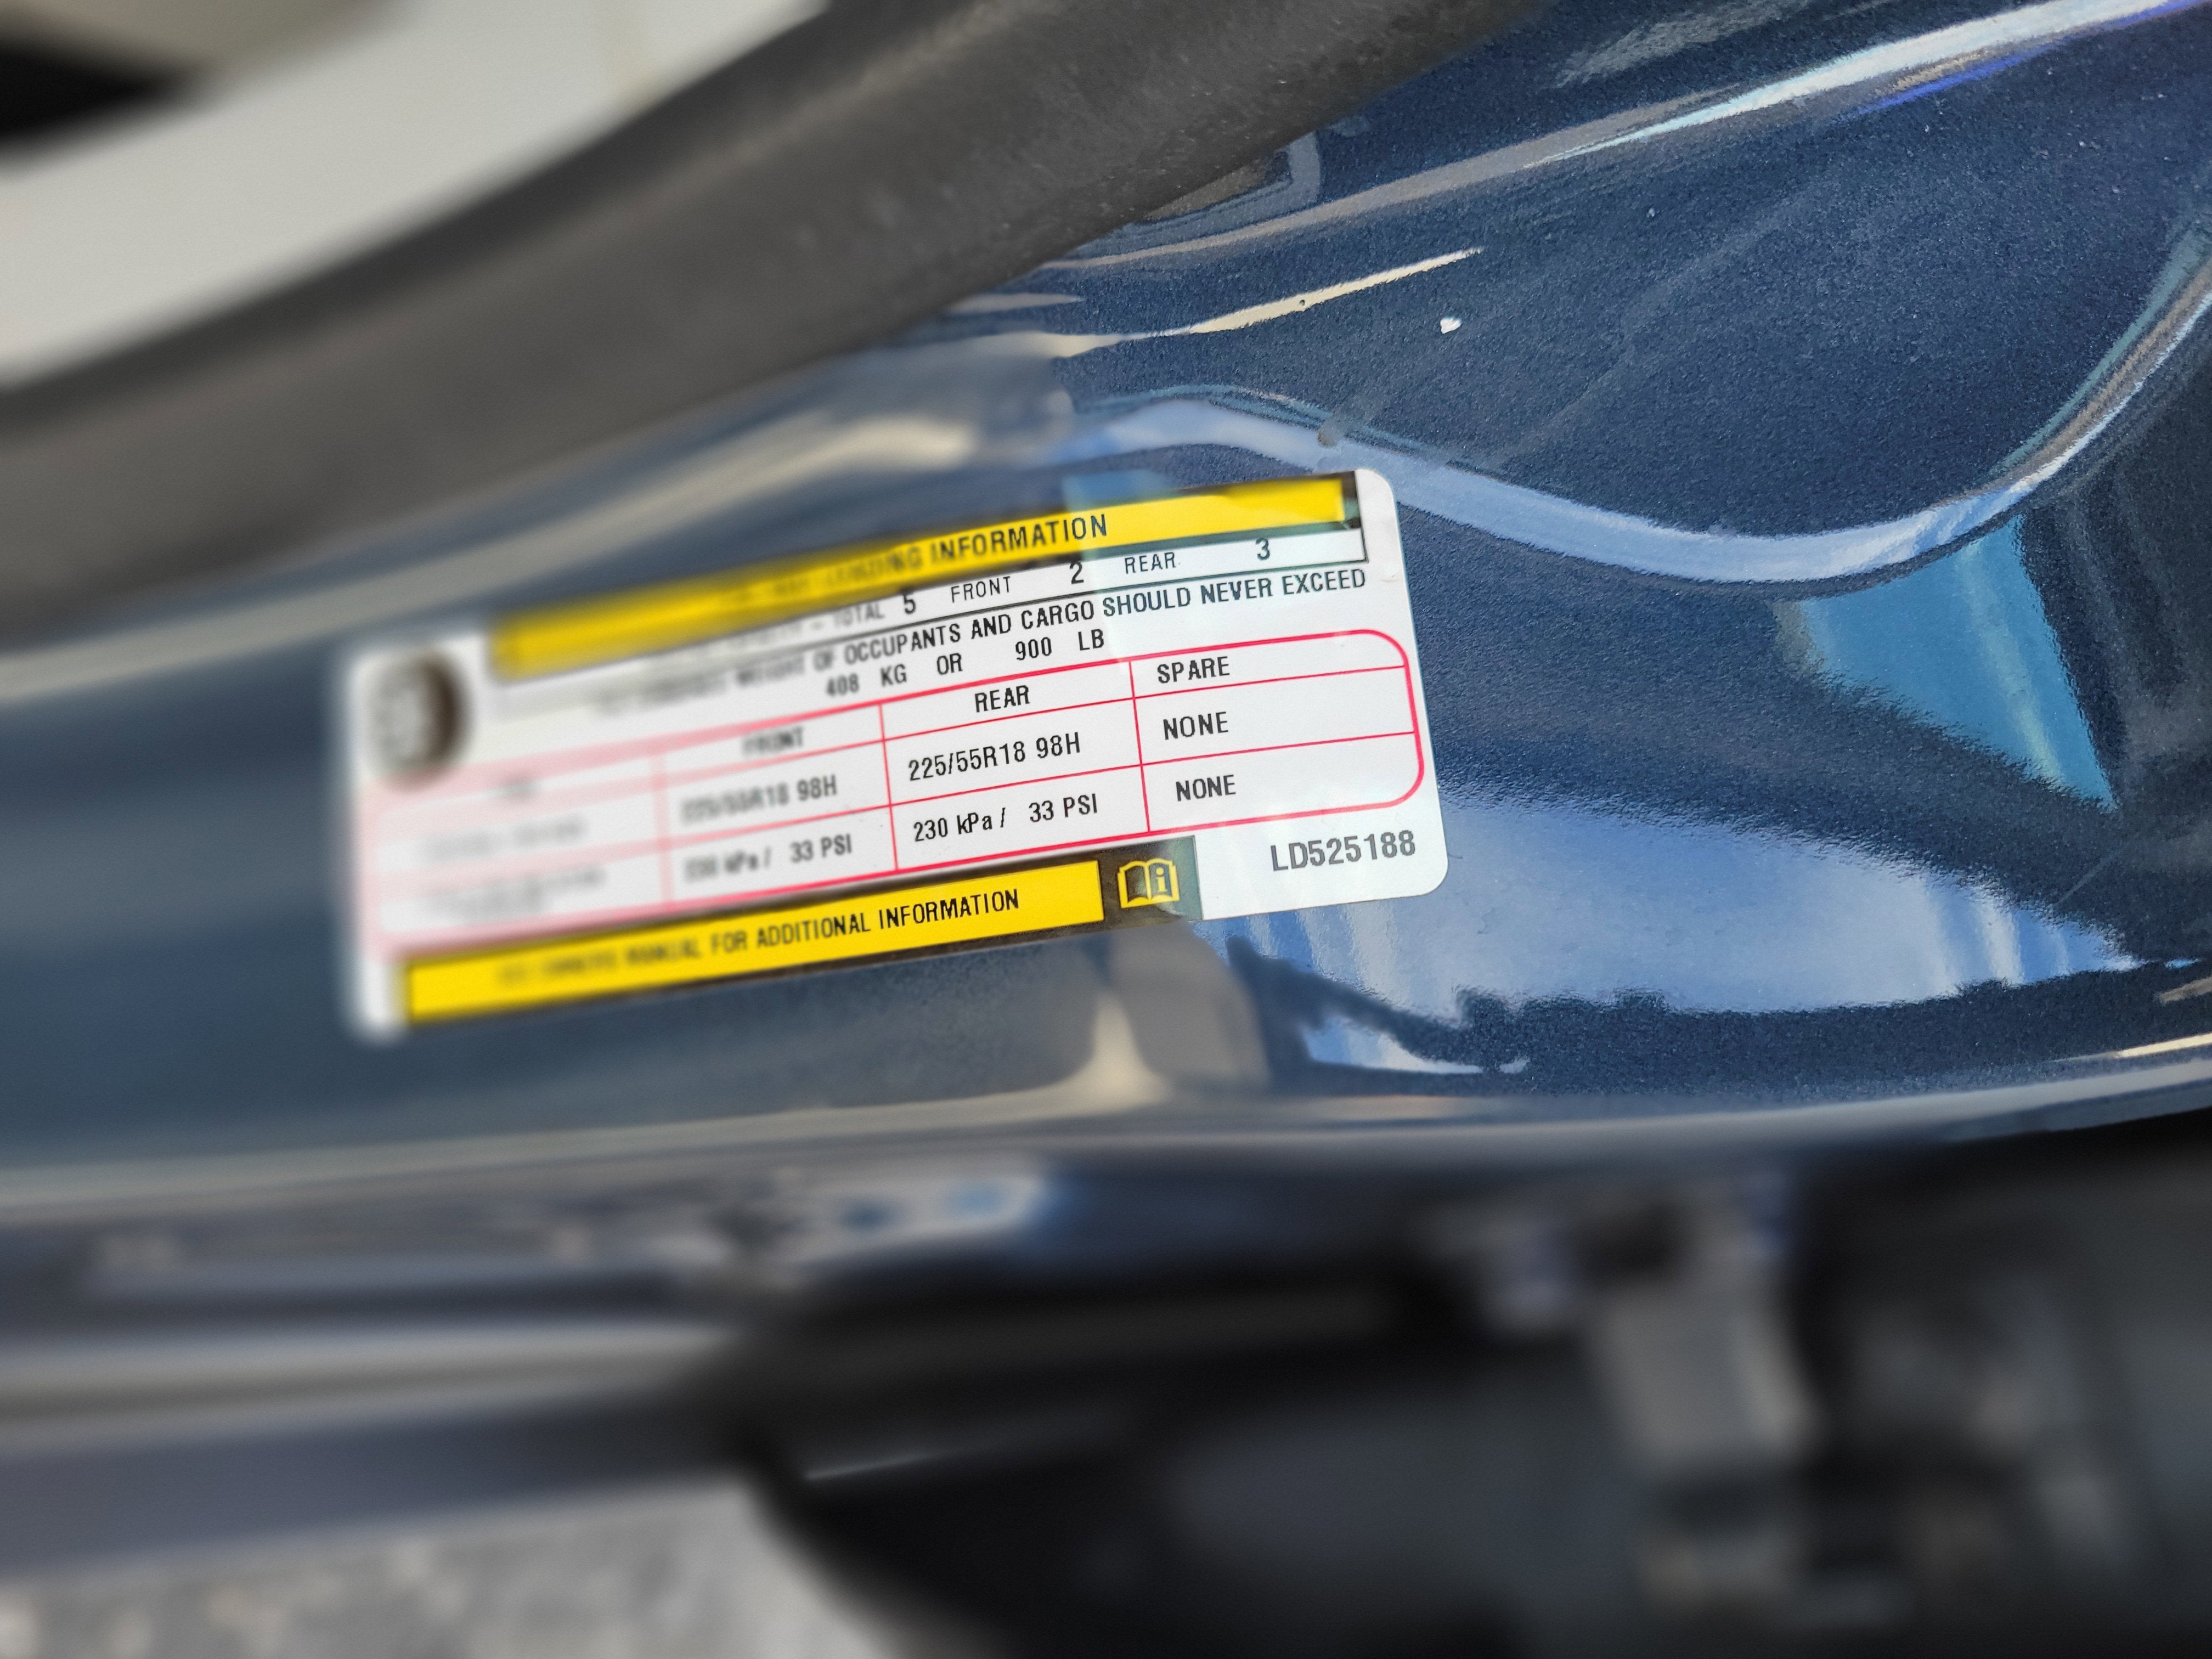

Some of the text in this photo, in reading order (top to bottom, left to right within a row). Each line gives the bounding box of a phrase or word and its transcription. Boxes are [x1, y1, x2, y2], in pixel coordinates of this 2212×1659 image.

[826, 514, 1107, 586] DING INFORMATION
[902, 591, 917, 615] 5
[951, 576, 1012, 603] FRONT
[1069, 561, 1084, 585] 2
[1125, 552, 1176, 574] REAR
[1255, 538, 1271, 560] 3
[844, 623, 961, 665] OCCUPANTS
[971, 613, 1012, 640] AND
[1021, 600, 1094, 630] CARGO
[1103, 587, 1191, 617] SHOULD
[1201, 578, 1272, 604] NEVER
[1282, 569, 1366, 595] EXCEED
[826, 674, 859, 697] 408
[881, 664, 907, 687] KG
[936, 652, 963, 676] OR
[1015, 636, 1052, 661] 900
[1078, 629, 1104, 651] LB
[1158, 656, 1230, 684] SPARE
[975, 685, 1030, 713] REAR
[1163, 711, 1229, 740] NONE
[909, 732, 1081, 781] 225/55R18 98H
[682, 774, 838, 825] 55R18 98H
[1176, 775, 1237, 802] NONE
[913, 818, 949, 842] 230
[956, 812, 993, 835] kPa
[1029, 800, 1054, 822] 33
[1063, 793, 1098, 817] PSI
[790, 840, 814, 864] 33
[821, 833, 852, 858] PSI
[1271, 830, 1416, 871] LD525188
[711, 930, 748, 956] FOR
[757, 912, 871, 949] ADDITIONAL
[879, 889, 1019, 929] INFORMATION
